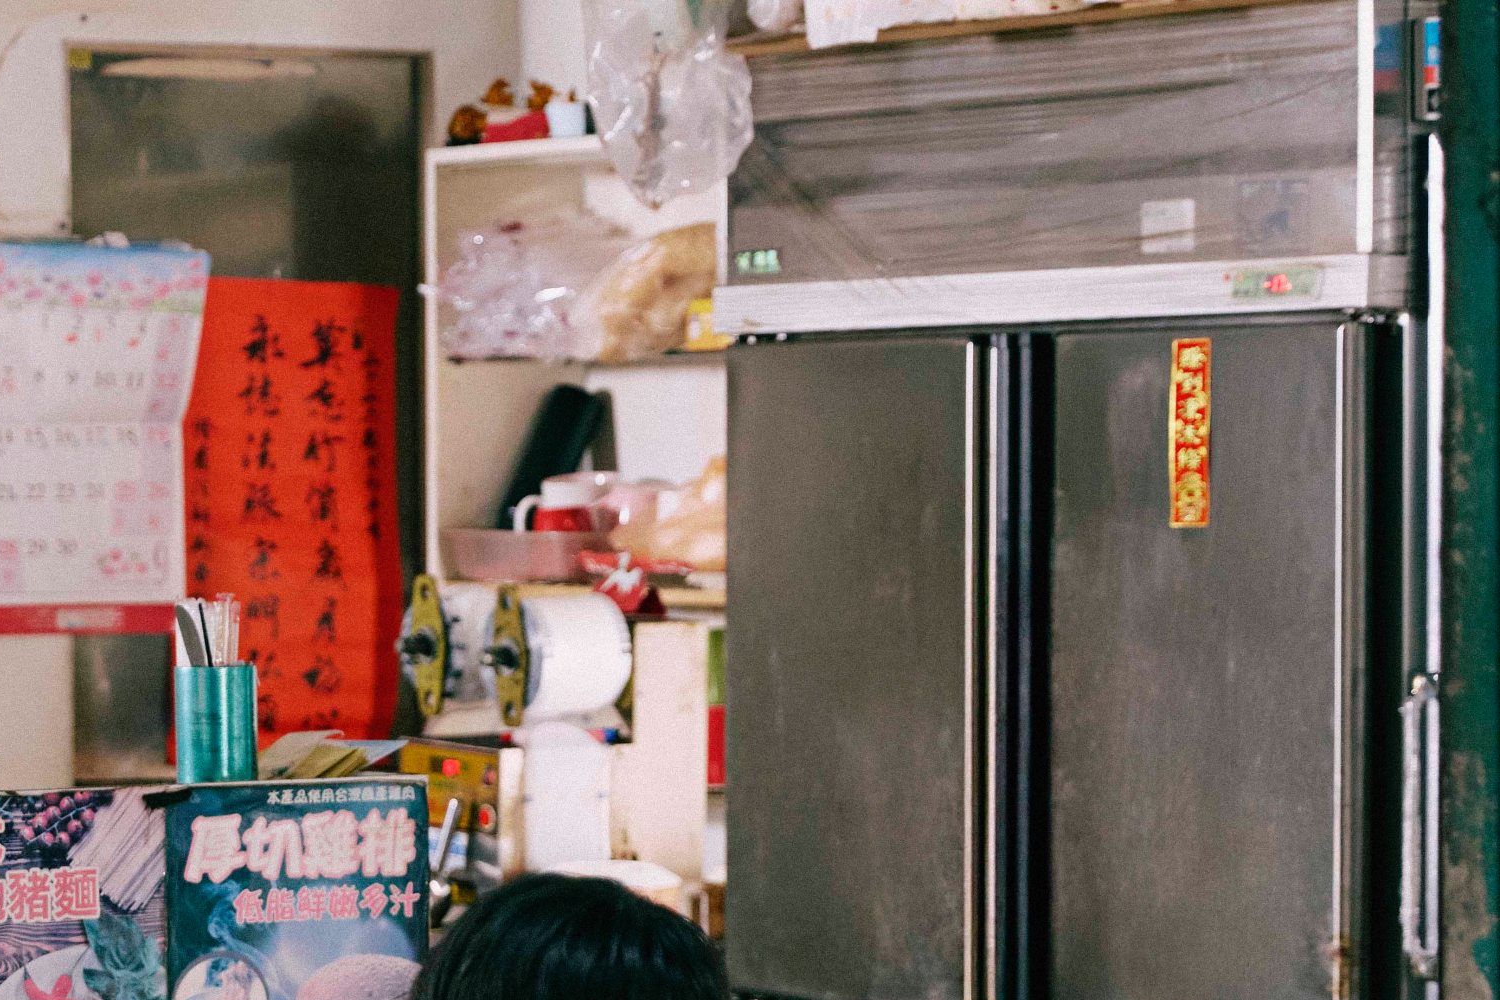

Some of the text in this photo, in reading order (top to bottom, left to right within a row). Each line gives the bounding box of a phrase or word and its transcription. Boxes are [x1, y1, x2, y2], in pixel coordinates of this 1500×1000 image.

[183, 807, 417, 884] 厚切雞排
[233, 881, 421, 926] 低脂鮮嫩多汁
